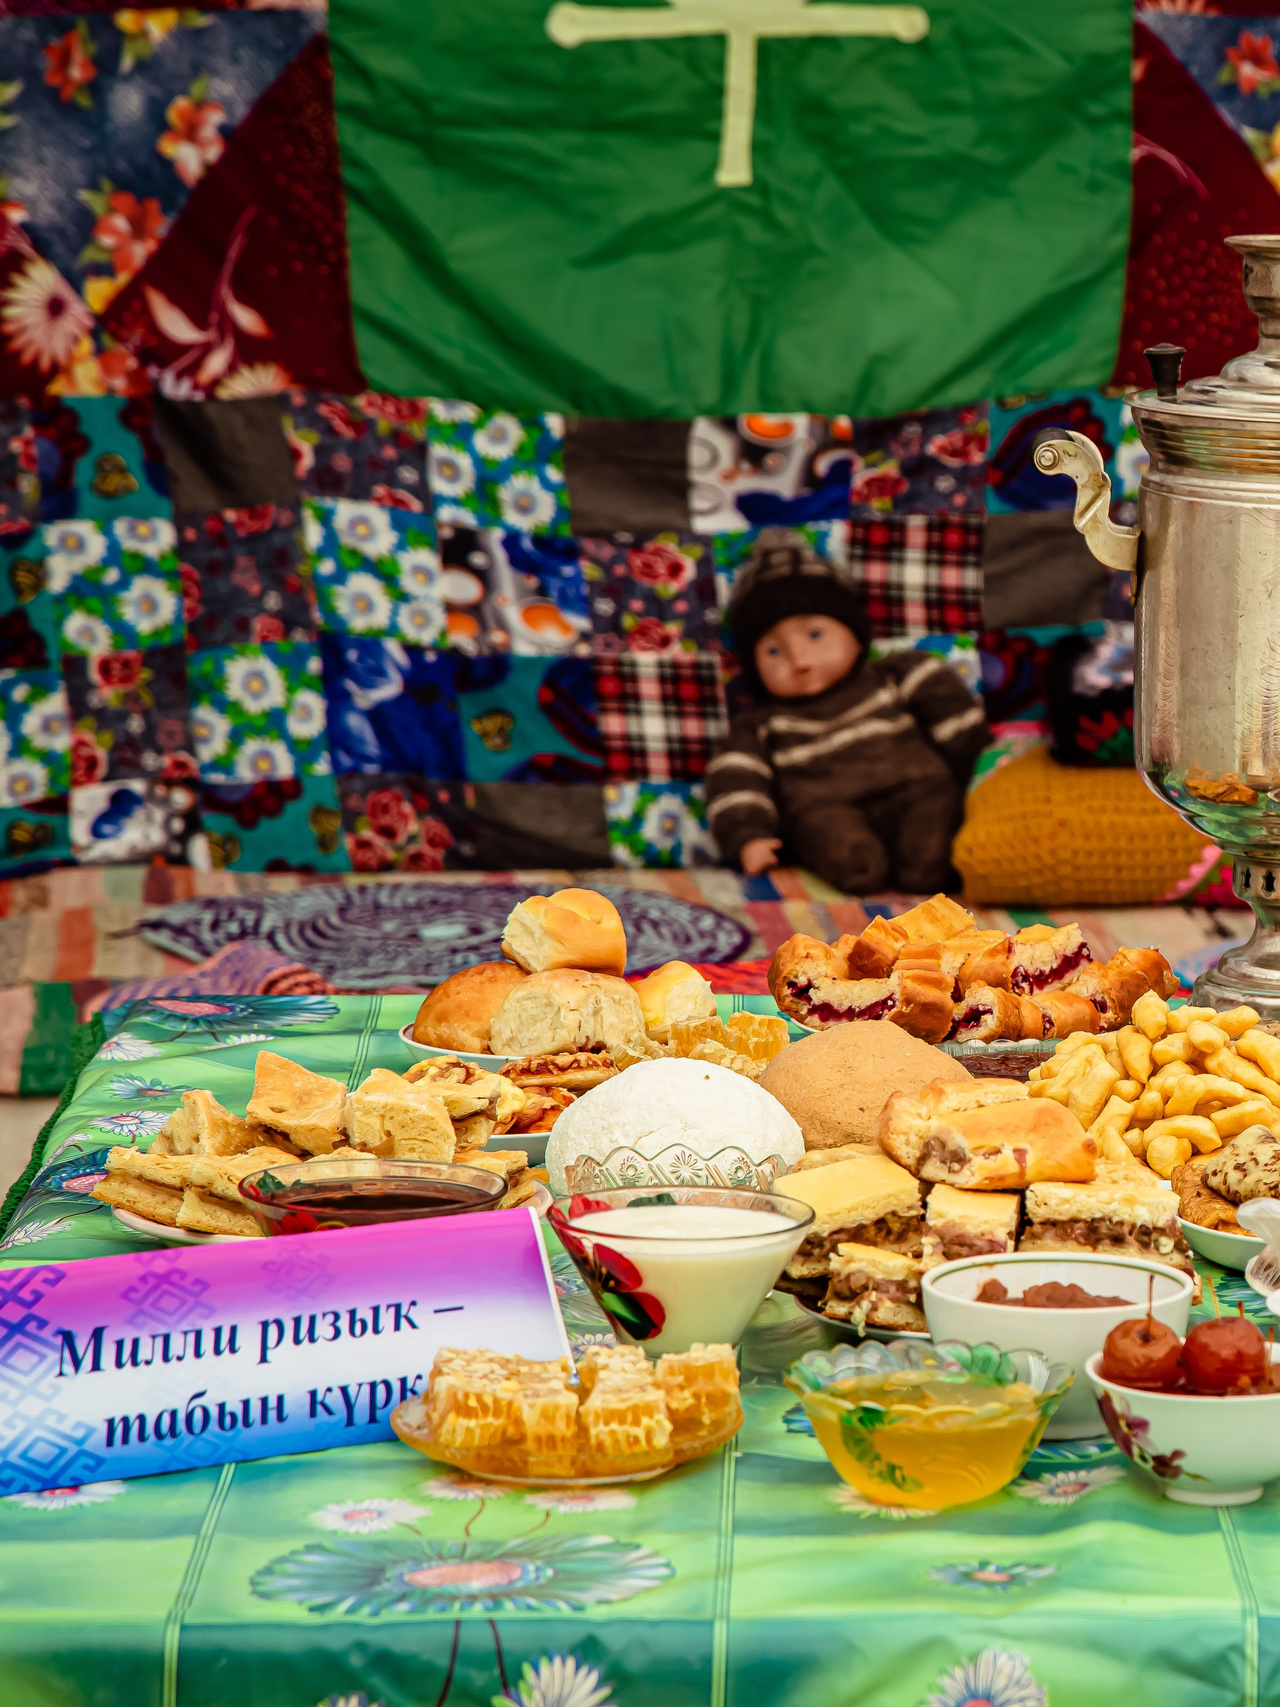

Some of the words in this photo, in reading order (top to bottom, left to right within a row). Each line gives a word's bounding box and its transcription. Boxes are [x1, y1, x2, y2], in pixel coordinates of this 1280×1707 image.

[54, 1325, 241, 1379] Милли
[103, 1388, 289, 1448] табын
[306, 1373, 424, 1428] күрк
